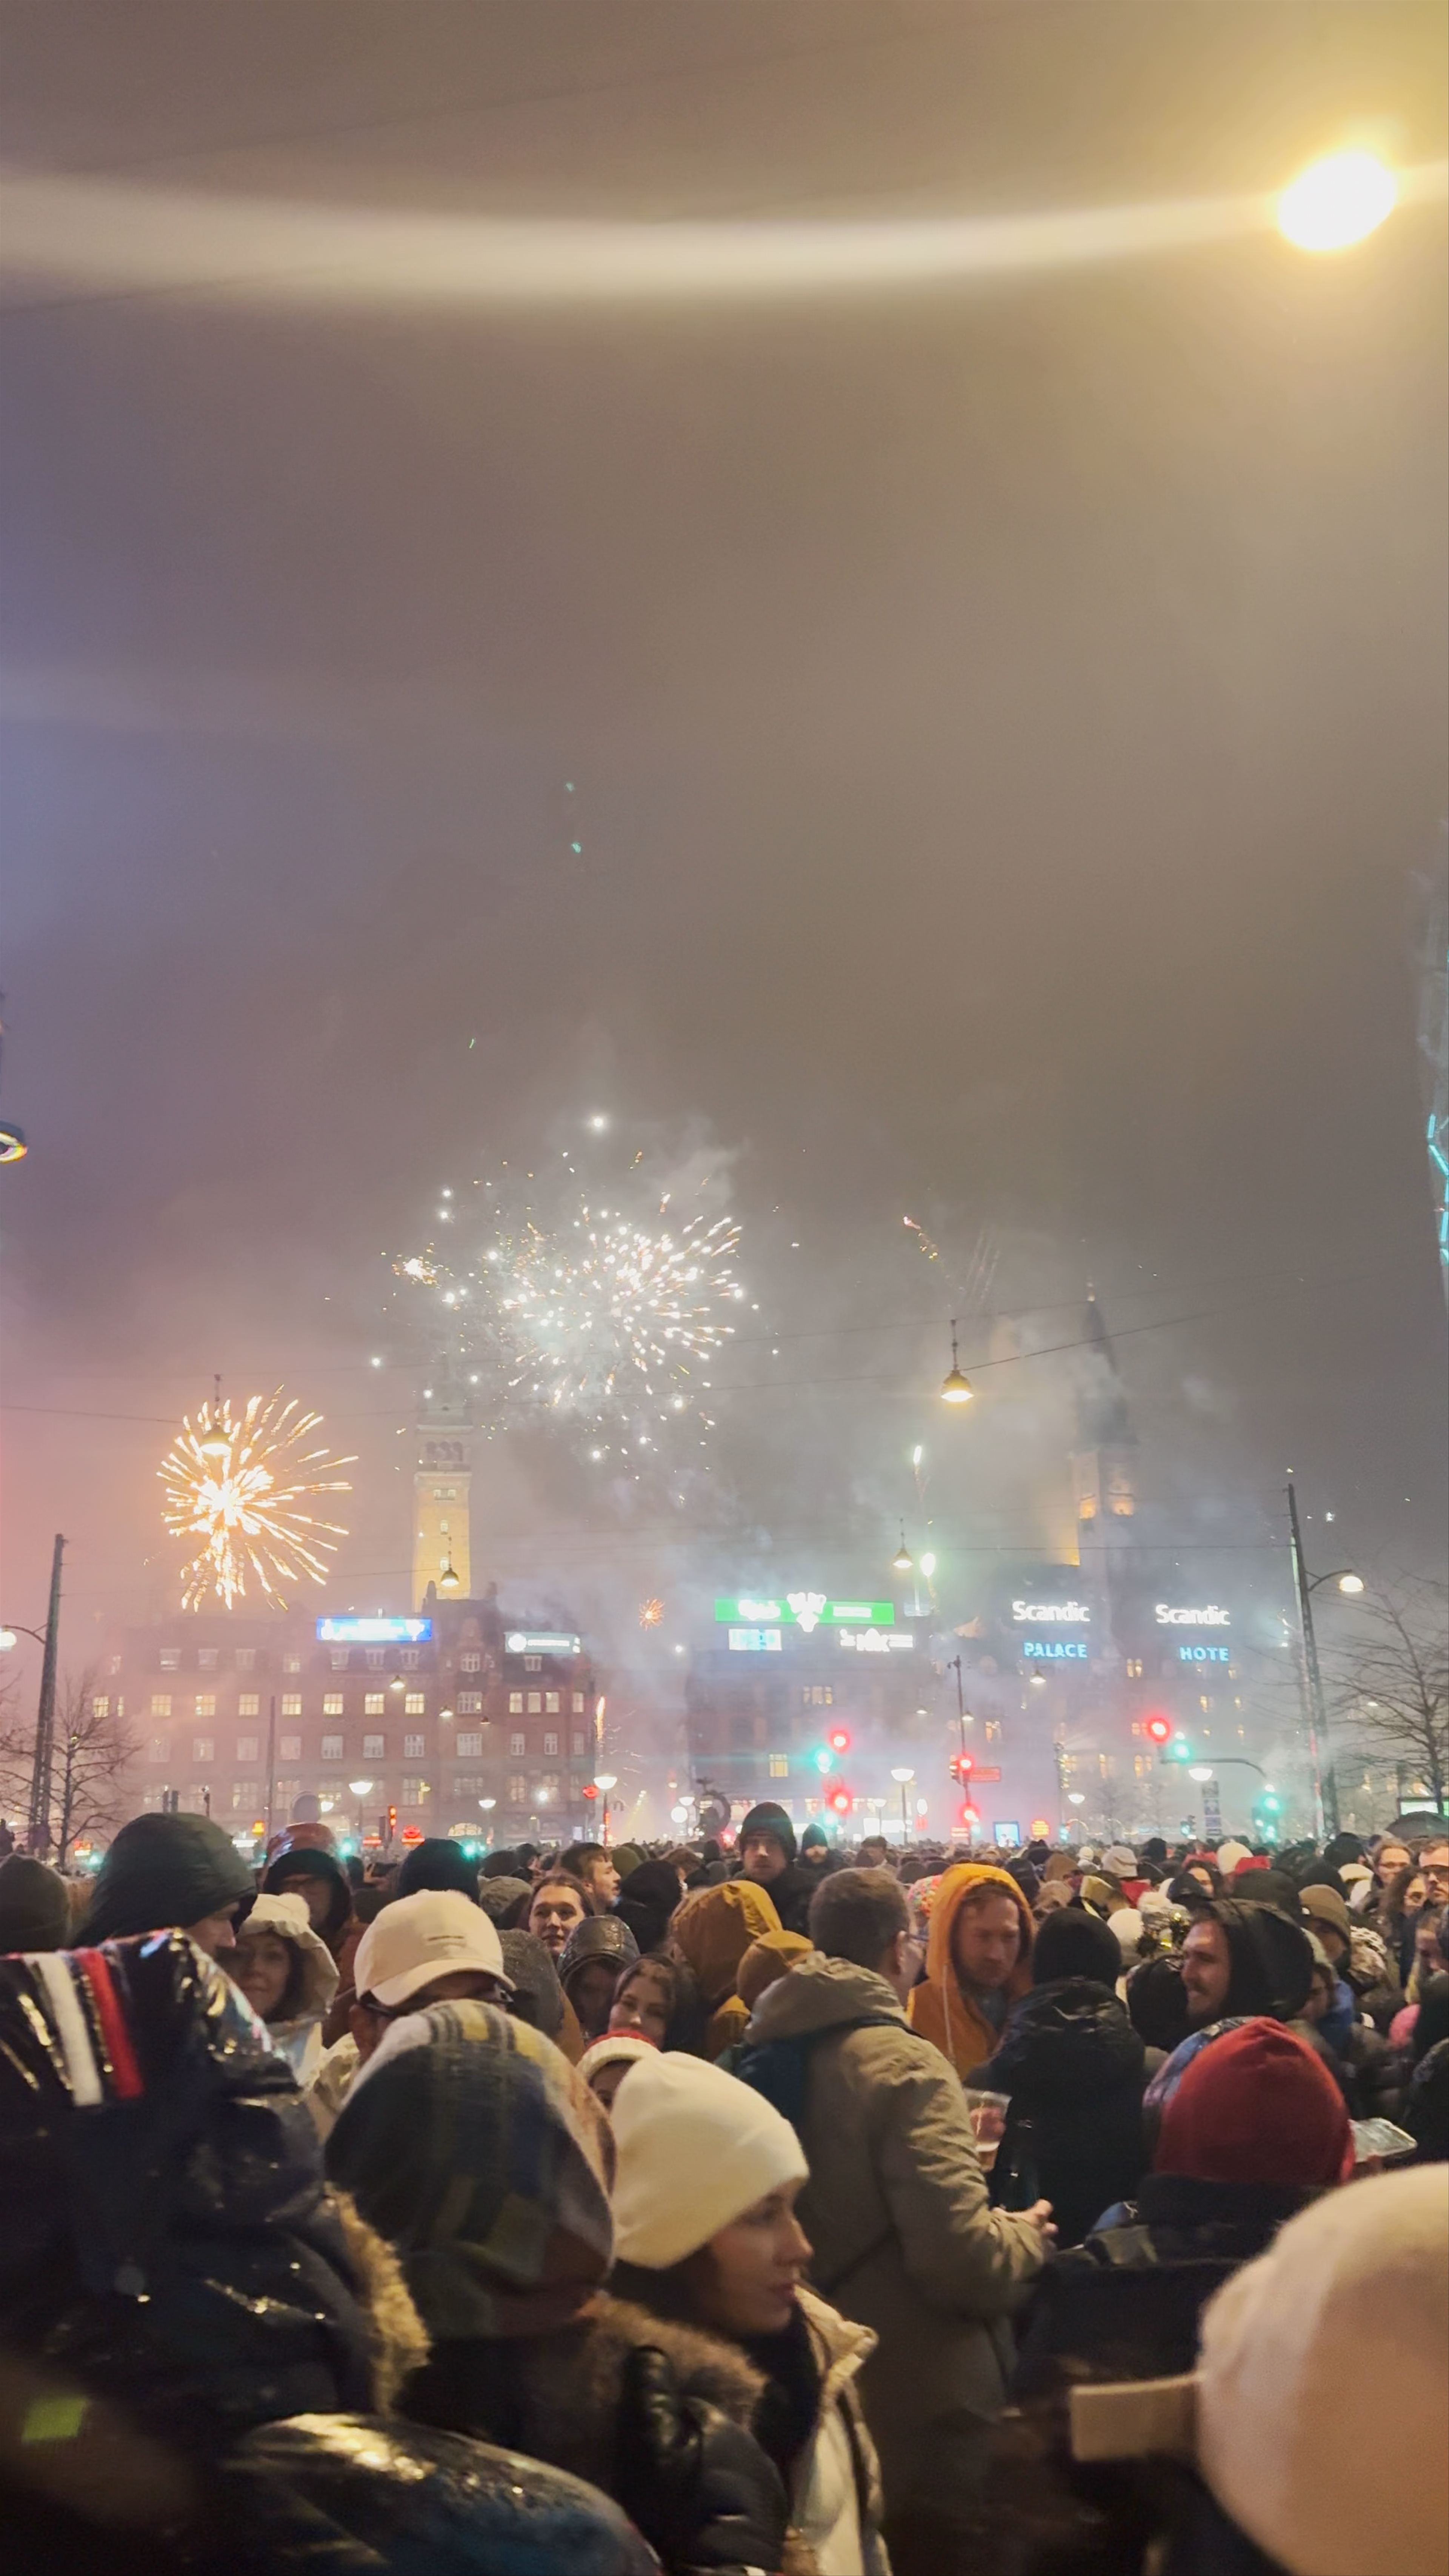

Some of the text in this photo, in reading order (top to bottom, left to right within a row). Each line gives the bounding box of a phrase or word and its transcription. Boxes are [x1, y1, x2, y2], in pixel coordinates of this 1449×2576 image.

[1012, 1601, 1090, 1621] Scandic
[1156, 1604, 1231, 1625] Scandic
[1024, 1642, 1088, 1658] PALACE
